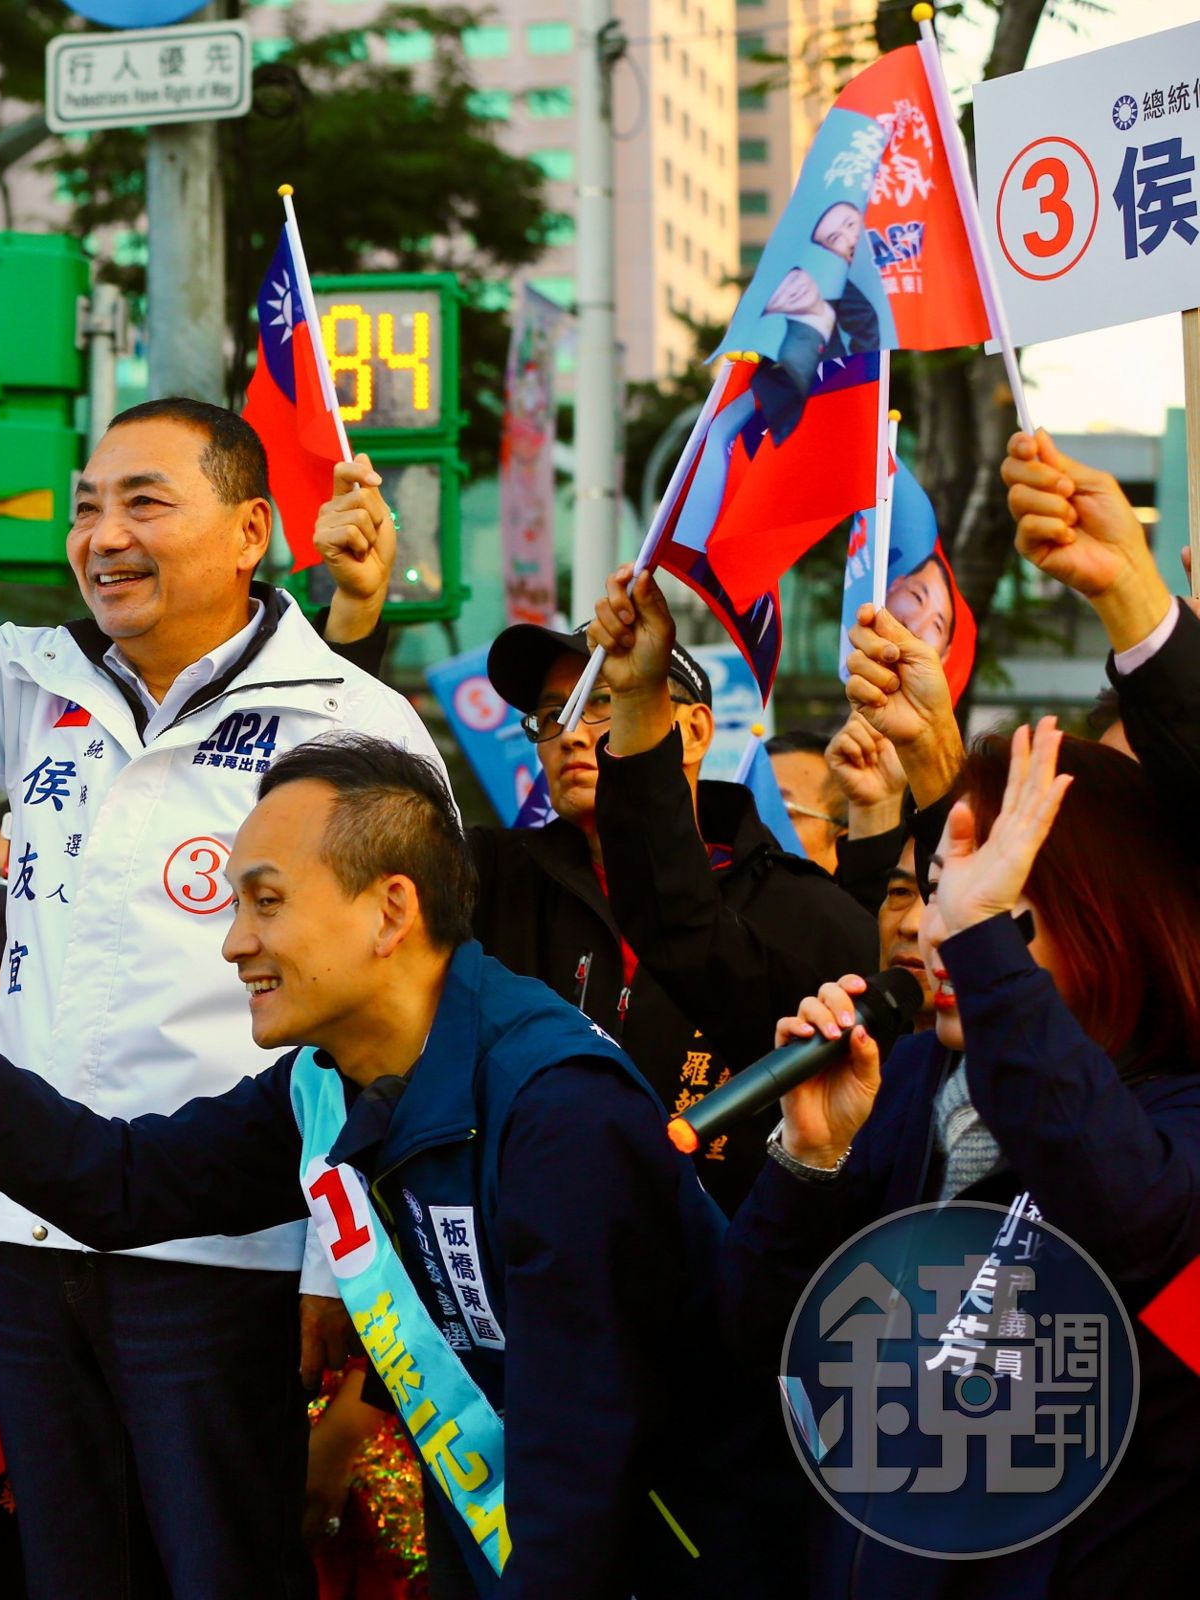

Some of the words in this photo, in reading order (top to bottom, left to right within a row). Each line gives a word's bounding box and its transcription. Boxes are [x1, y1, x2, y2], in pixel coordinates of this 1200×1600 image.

[68, 44, 233, 85] 行人優先
[1022, 157, 1074, 258] 3
[321, 305, 430, 422] 84
[198, 712, 280, 757] 2024
[8, 755, 77, 994] 侯友宜
[182, 848, 220, 901] 3
[309, 1167, 371, 1262] 1
[440, 1217, 500, 1340] 板橋東區
